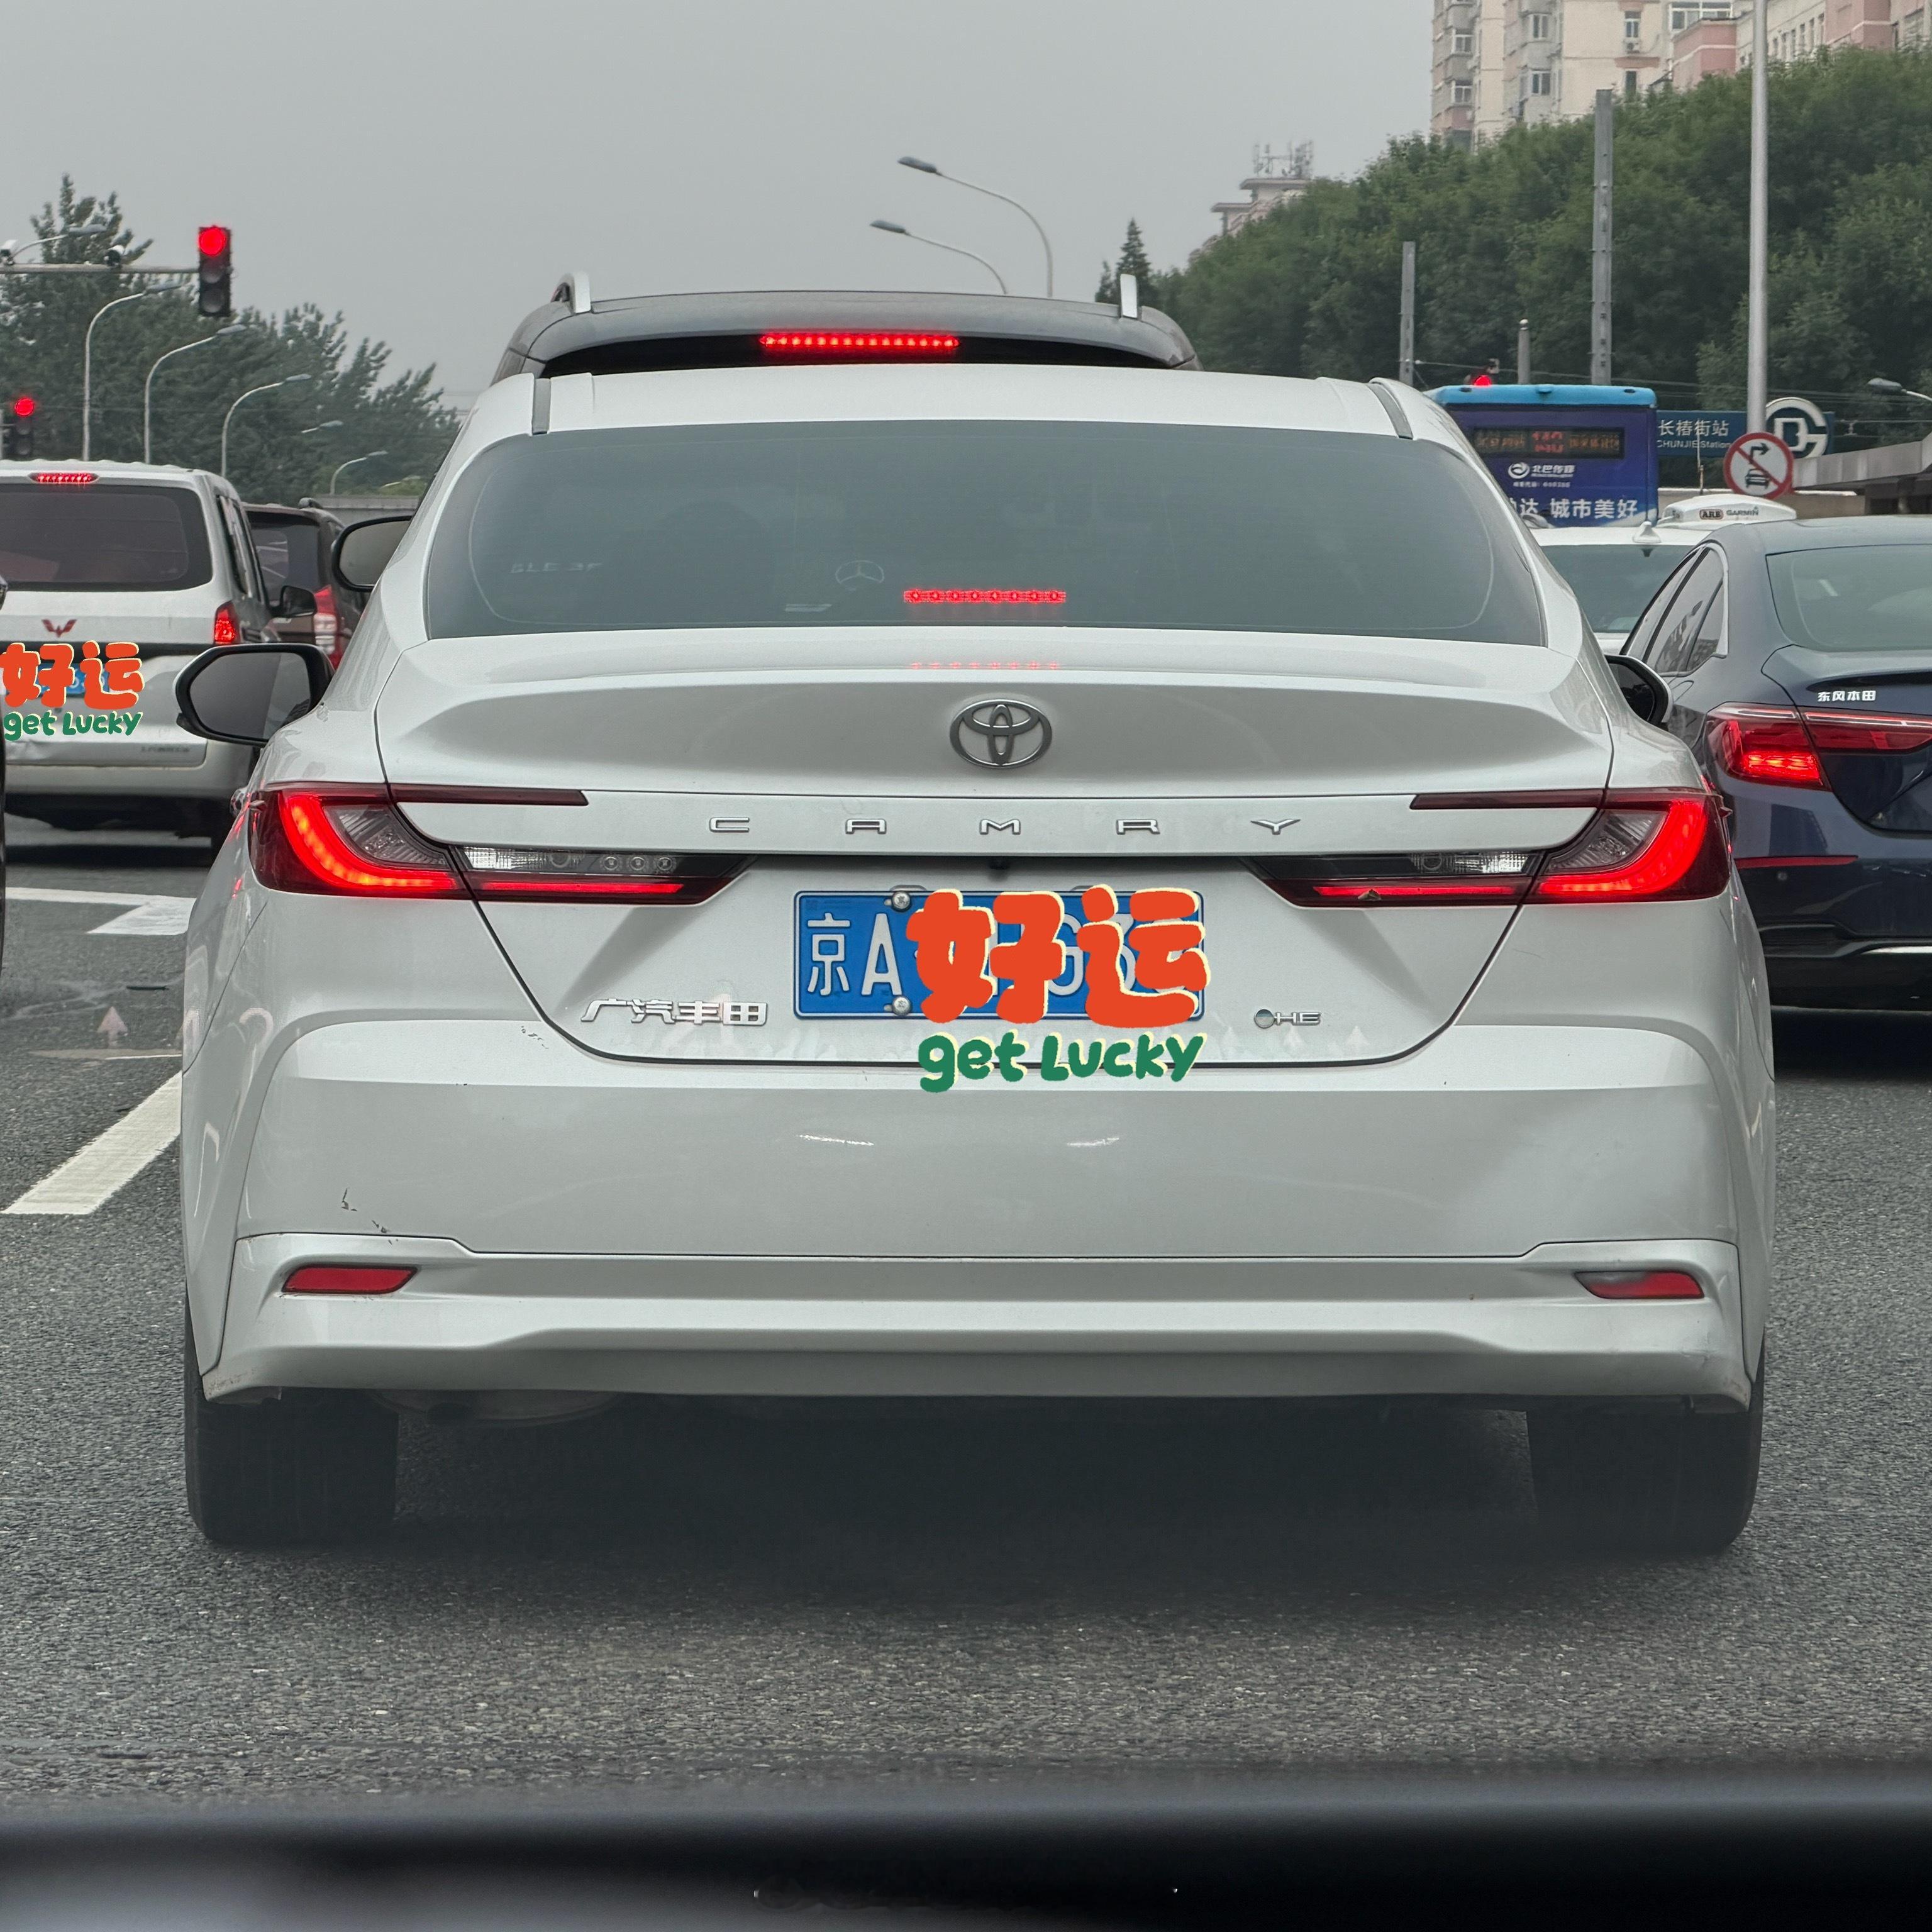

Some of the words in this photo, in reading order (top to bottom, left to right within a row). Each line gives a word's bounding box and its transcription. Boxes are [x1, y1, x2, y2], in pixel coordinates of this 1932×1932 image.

[1658, 419, 1729, 436] 长椿街站
[1550, 498, 1638, 519] 城市美好
[1818, 691, 1876, 701] 东风本田
[709, 817, 1301, 835] CAMRY
[580, 998, 768, 1026] 广汽丰田
